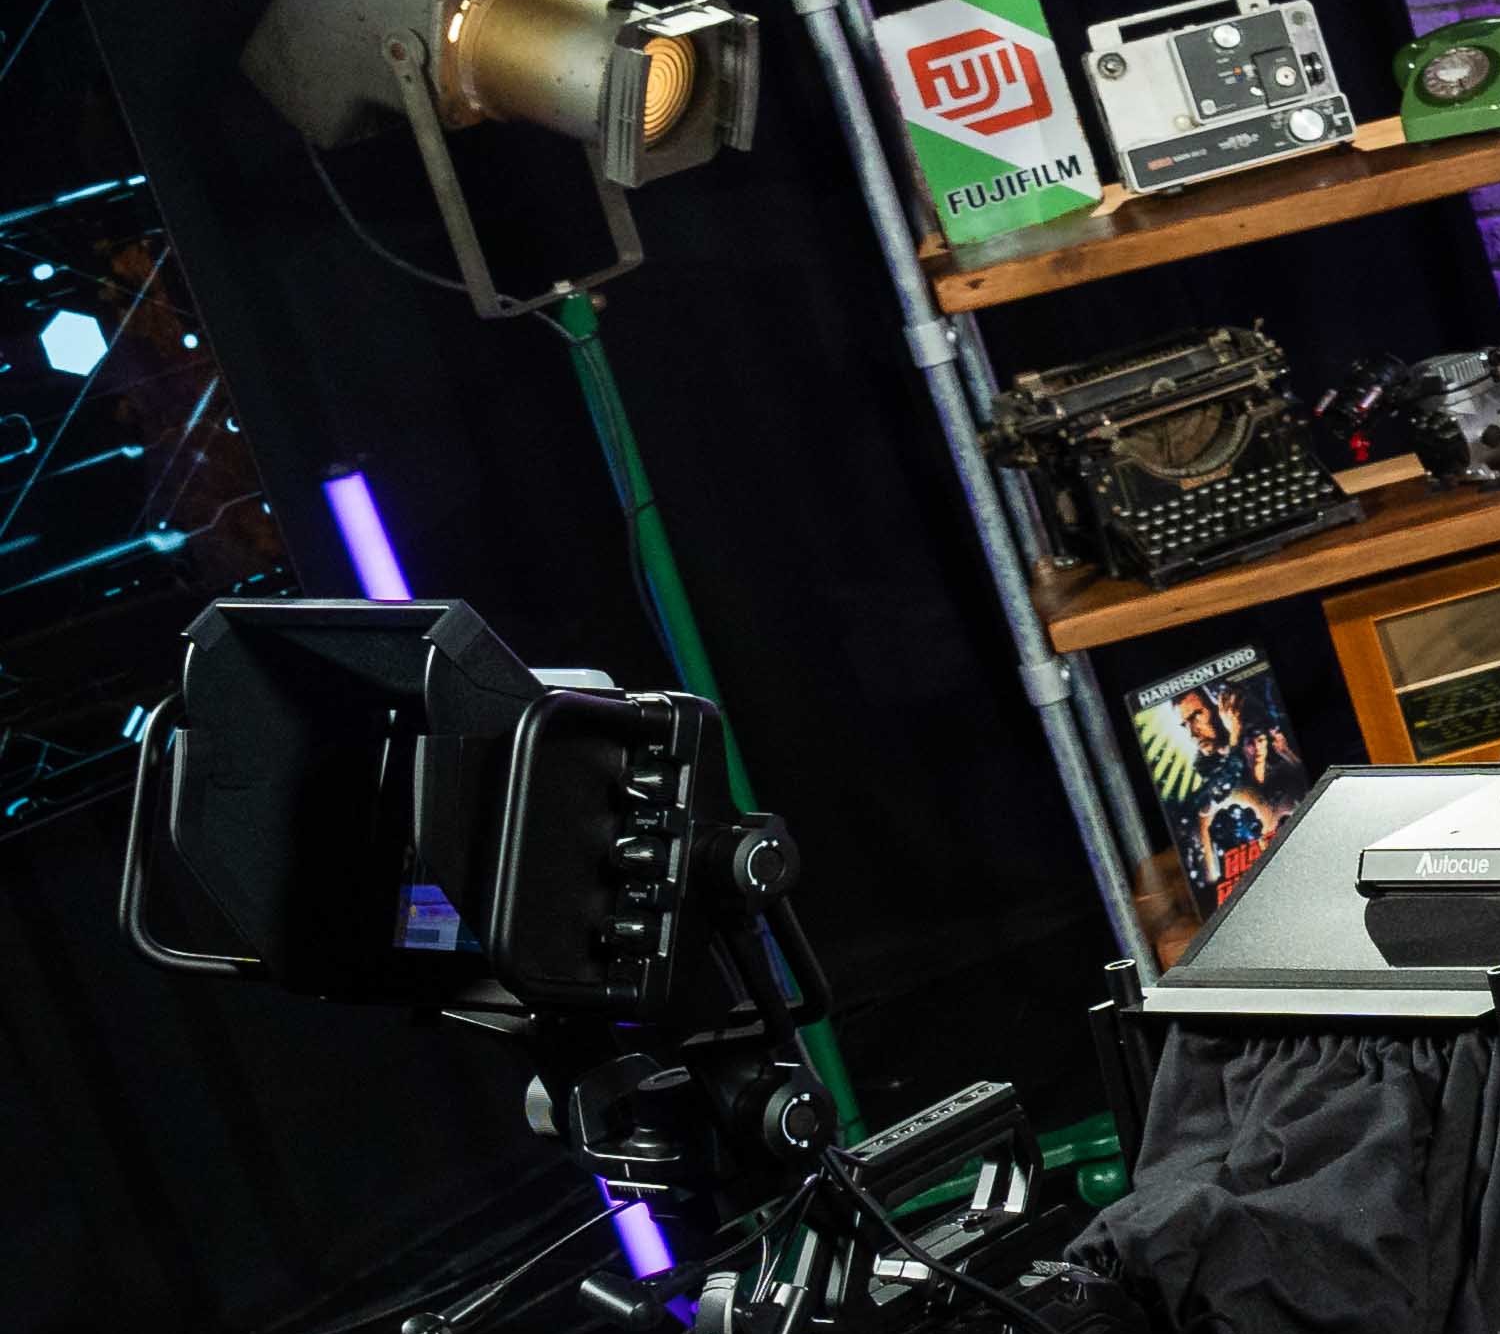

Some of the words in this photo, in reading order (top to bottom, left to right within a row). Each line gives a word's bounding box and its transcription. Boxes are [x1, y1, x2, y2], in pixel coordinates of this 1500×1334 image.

[947, 154, 1083, 215] FUJIFILM
[1138, 665, 1215, 708] HARRISON
[1214, 647, 1257, 676] FORD
[1415, 851, 1490, 877] Autocue
